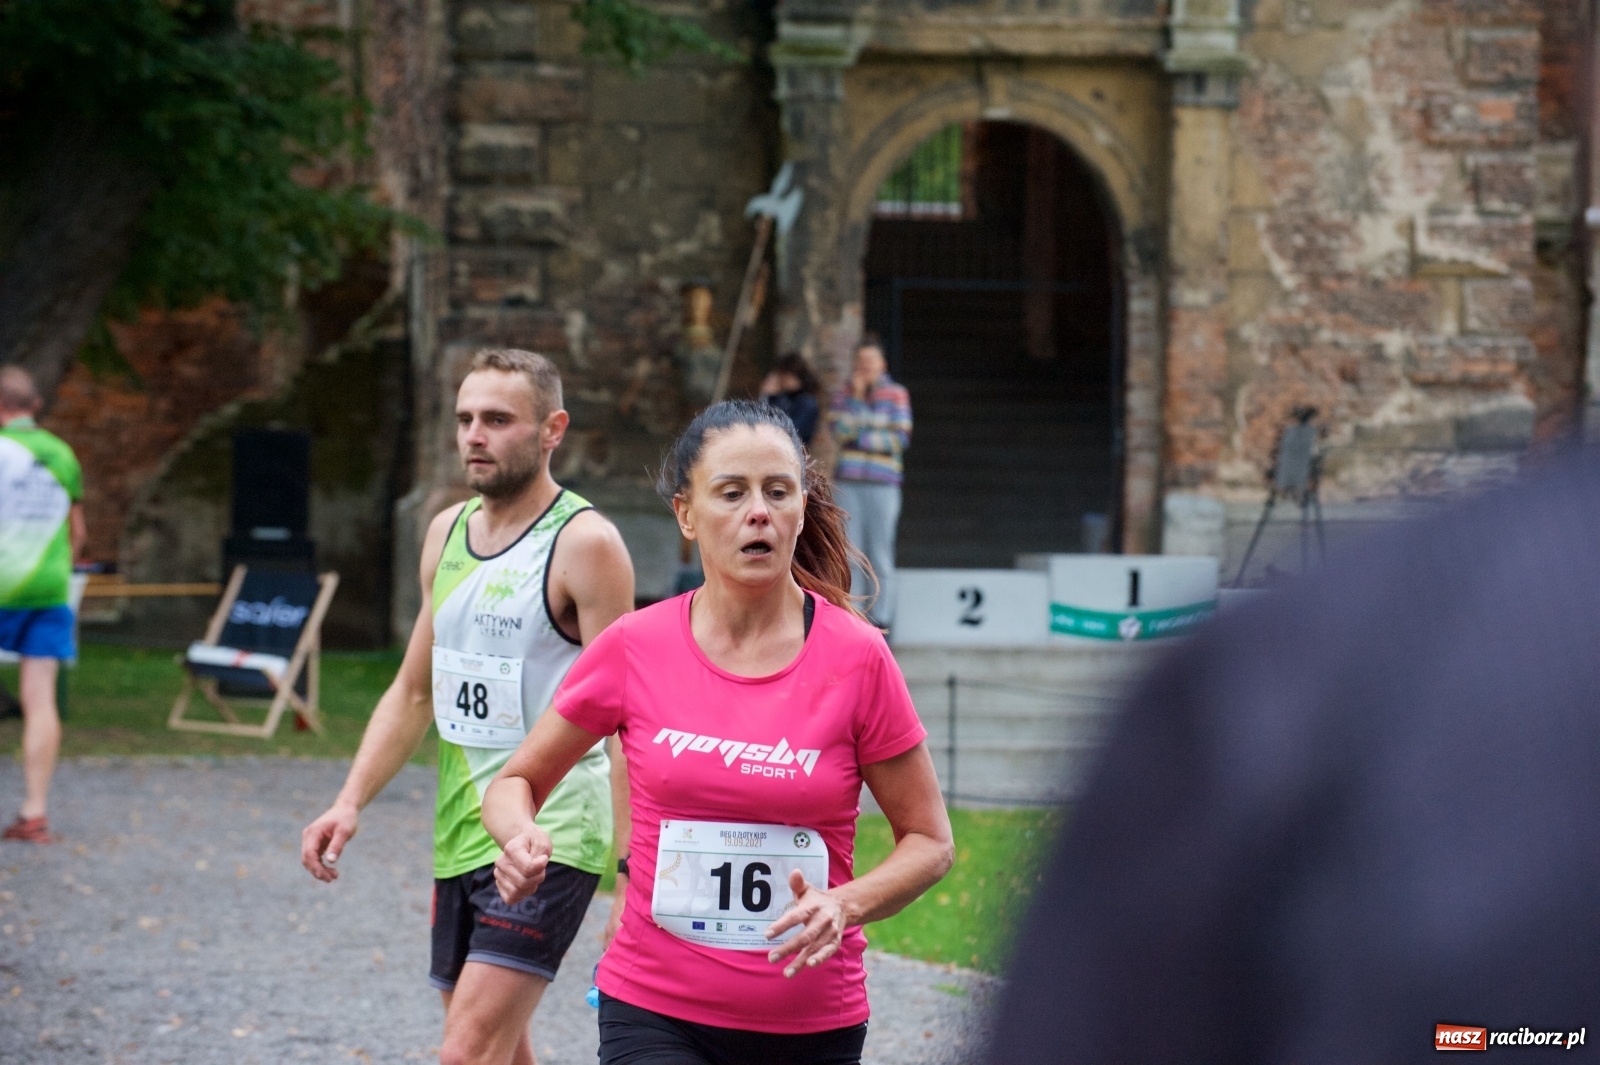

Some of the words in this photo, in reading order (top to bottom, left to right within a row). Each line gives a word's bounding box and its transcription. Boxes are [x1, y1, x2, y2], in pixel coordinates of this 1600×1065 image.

[229, 597, 308, 627] safer
[474, 613, 523, 630] AKTYWNI
[957, 586, 984, 627] 2
[456, 681, 489, 720] 48
[740, 763, 797, 780] SPORT
[724, 837, 762, 848] 19.09.2021
[710, 861, 772, 913] 16
